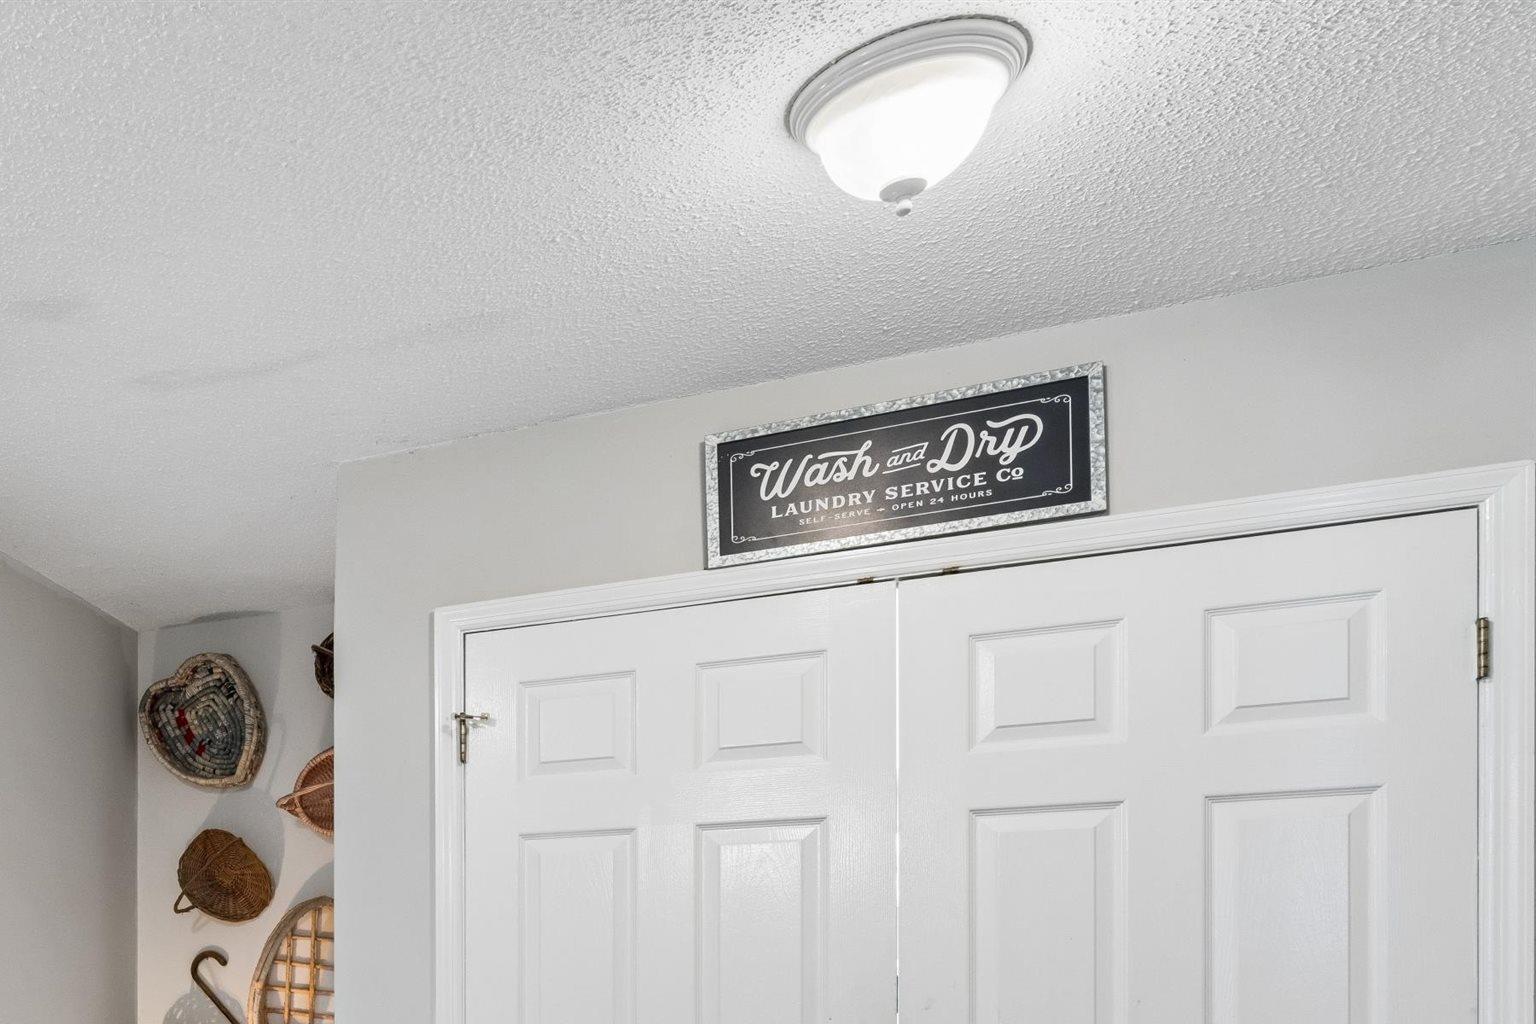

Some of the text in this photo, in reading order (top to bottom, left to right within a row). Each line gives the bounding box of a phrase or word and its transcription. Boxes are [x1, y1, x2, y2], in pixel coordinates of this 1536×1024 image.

[750, 413, 1044, 501] Wash and Dry
[771, 489, 876, 519] LAUNDRY
[885, 471, 987, 500] SERVICE
[799, 489, 993, 526] SELF-SERVE OPEN 24 HOURS
